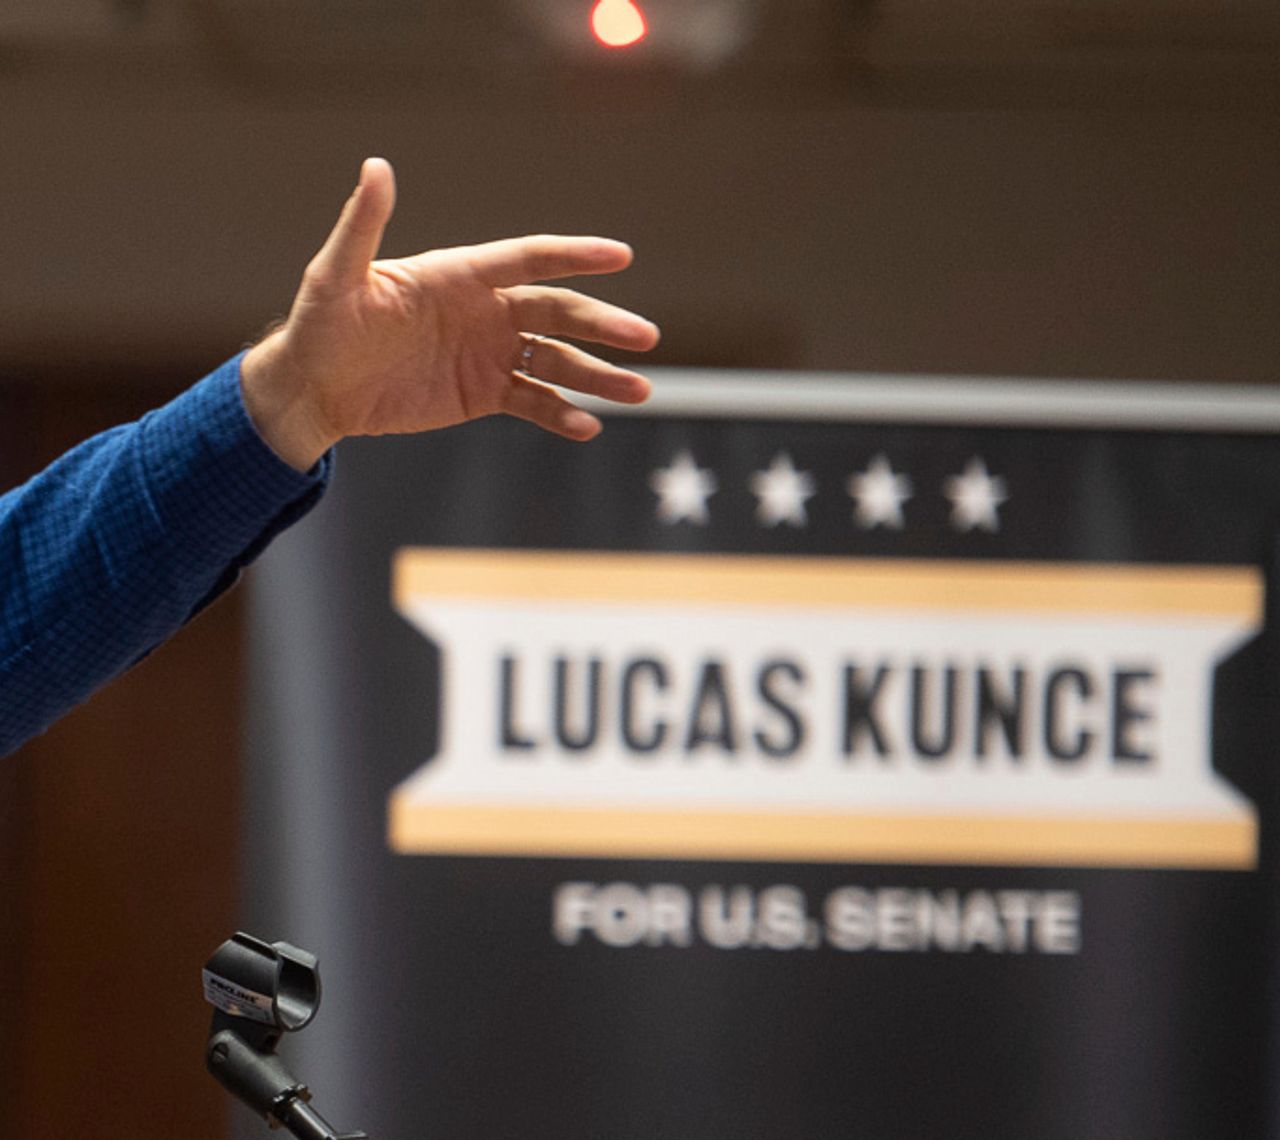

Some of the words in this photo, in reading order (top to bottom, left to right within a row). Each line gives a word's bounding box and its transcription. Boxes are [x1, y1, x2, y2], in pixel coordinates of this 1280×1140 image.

[496, 655, 810, 761] LUCAS
[838, 661, 1157, 766] KUNCE
[552, 881, 693, 948] FOR
[697, 883, 821, 950] U.S.
[824, 887, 1083, 955] SENATE
